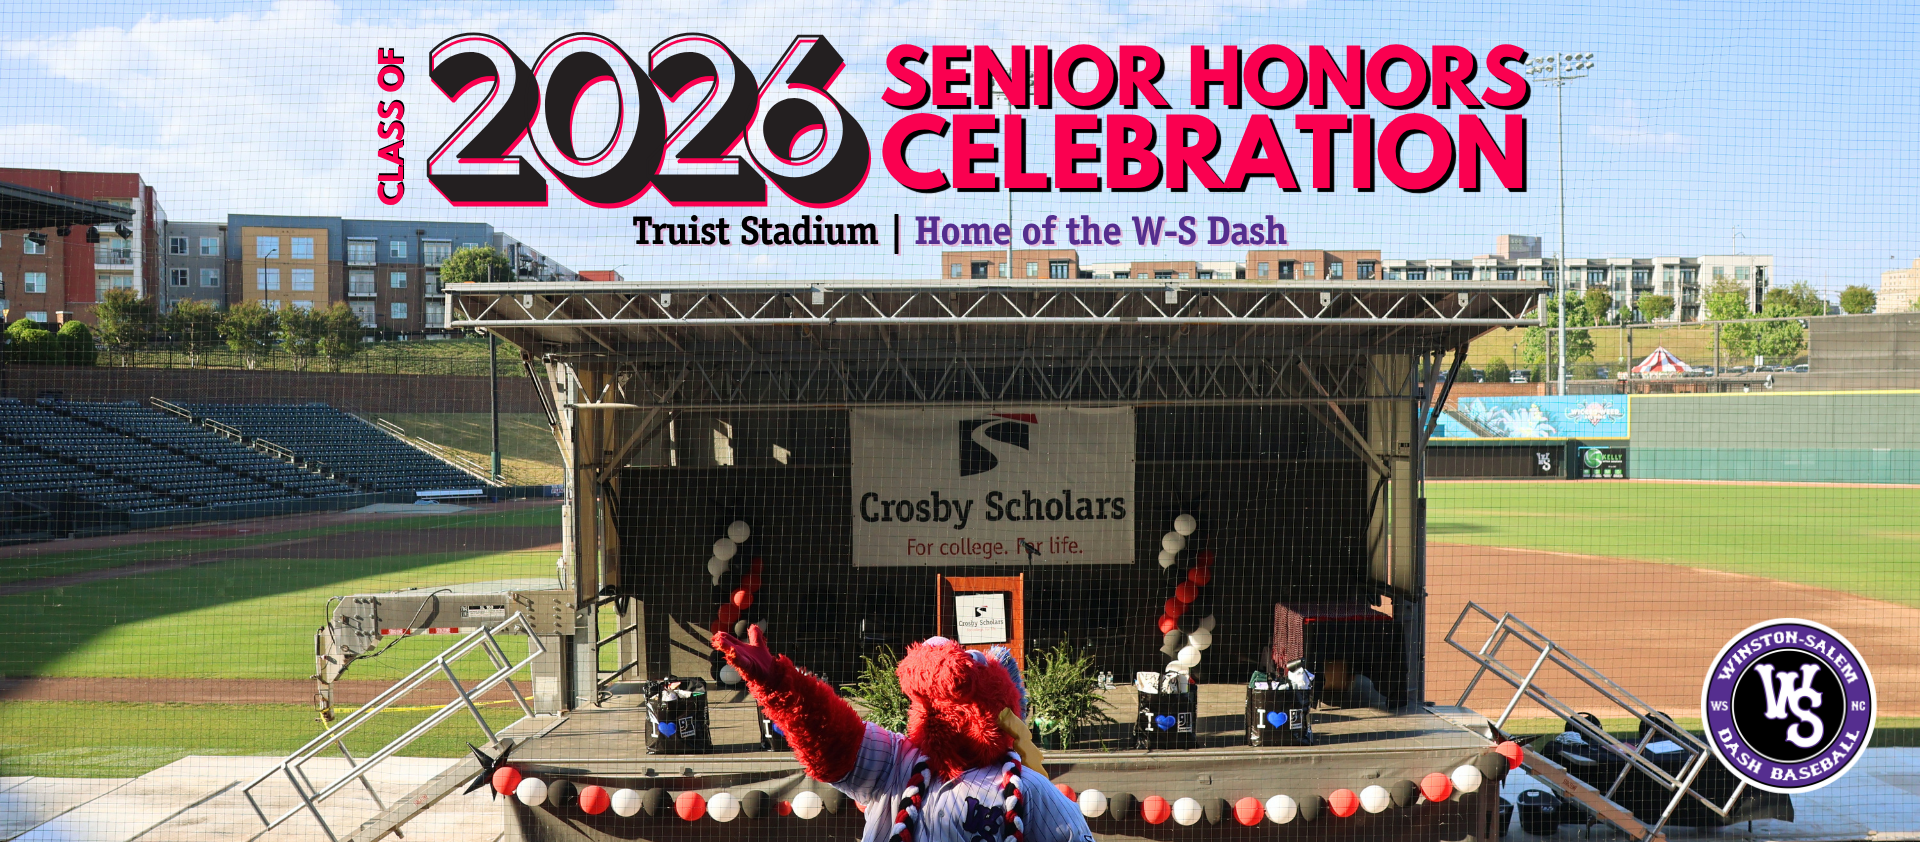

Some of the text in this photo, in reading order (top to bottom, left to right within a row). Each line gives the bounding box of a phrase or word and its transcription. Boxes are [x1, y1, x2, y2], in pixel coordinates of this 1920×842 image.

[859, 489, 1127, 530] Crosby Scholars
[907, 538, 934, 556] For
[939, 538, 1009, 559] college.
[1049, 535, 1084, 554] life.
